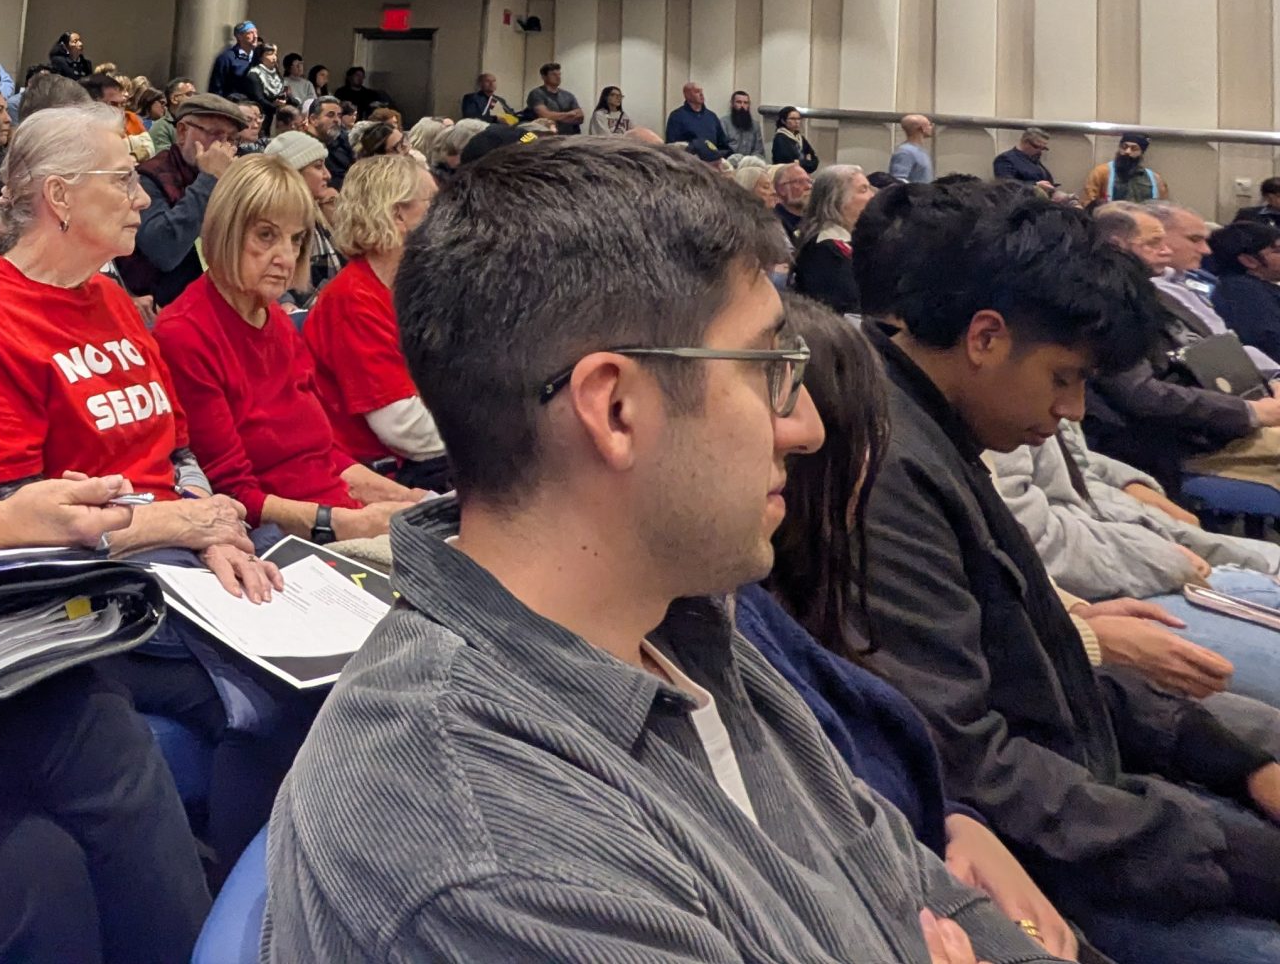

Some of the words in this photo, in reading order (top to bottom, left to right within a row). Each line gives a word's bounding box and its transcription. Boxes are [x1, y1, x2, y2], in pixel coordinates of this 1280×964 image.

[52, 343, 113, 384] NO
[103, 338, 146, 371] TO
[86, 381, 172, 430] SEDA
